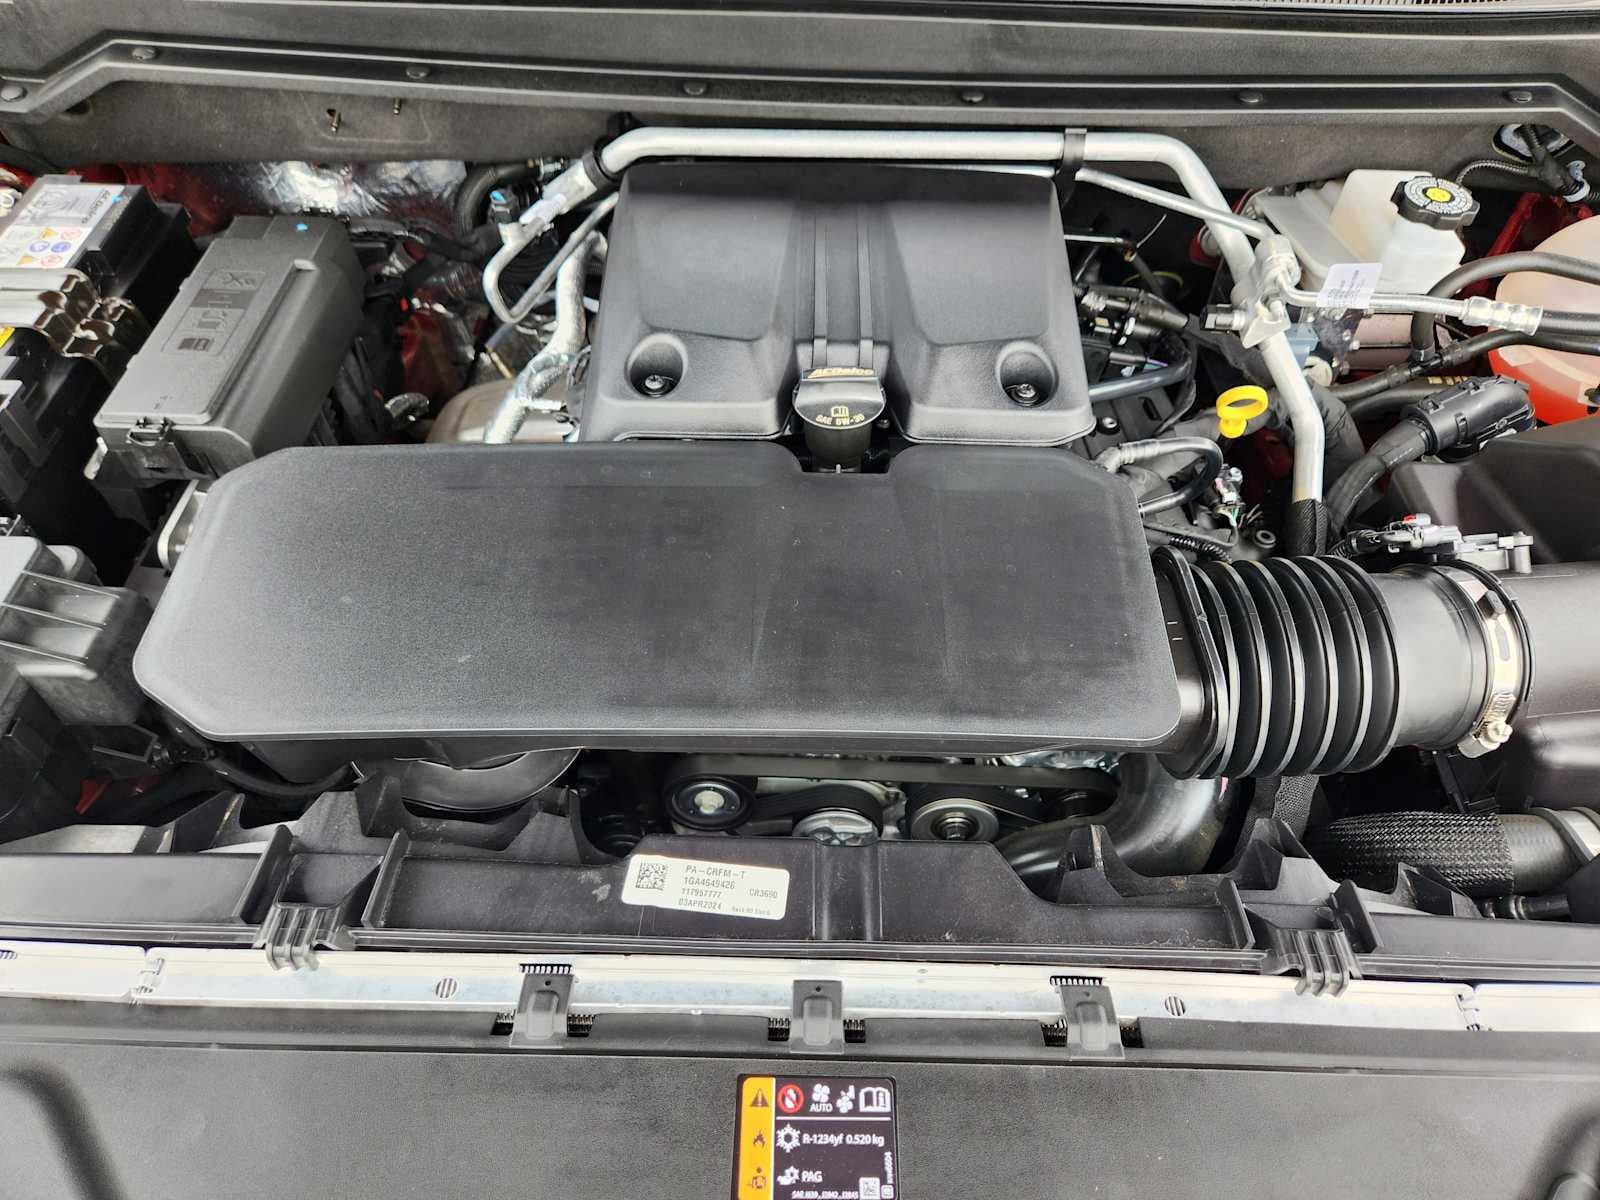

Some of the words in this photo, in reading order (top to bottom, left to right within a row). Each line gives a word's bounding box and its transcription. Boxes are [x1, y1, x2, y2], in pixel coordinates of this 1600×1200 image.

[809, 1103, 833, 1113] AUTO
[802, 1133, 844, 1147] R-1234yf
[846, 1133, 871, 1146] 0.520
[872, 1133, 885, 1147] kg
[801, 1170, 823, 1183] PAG
